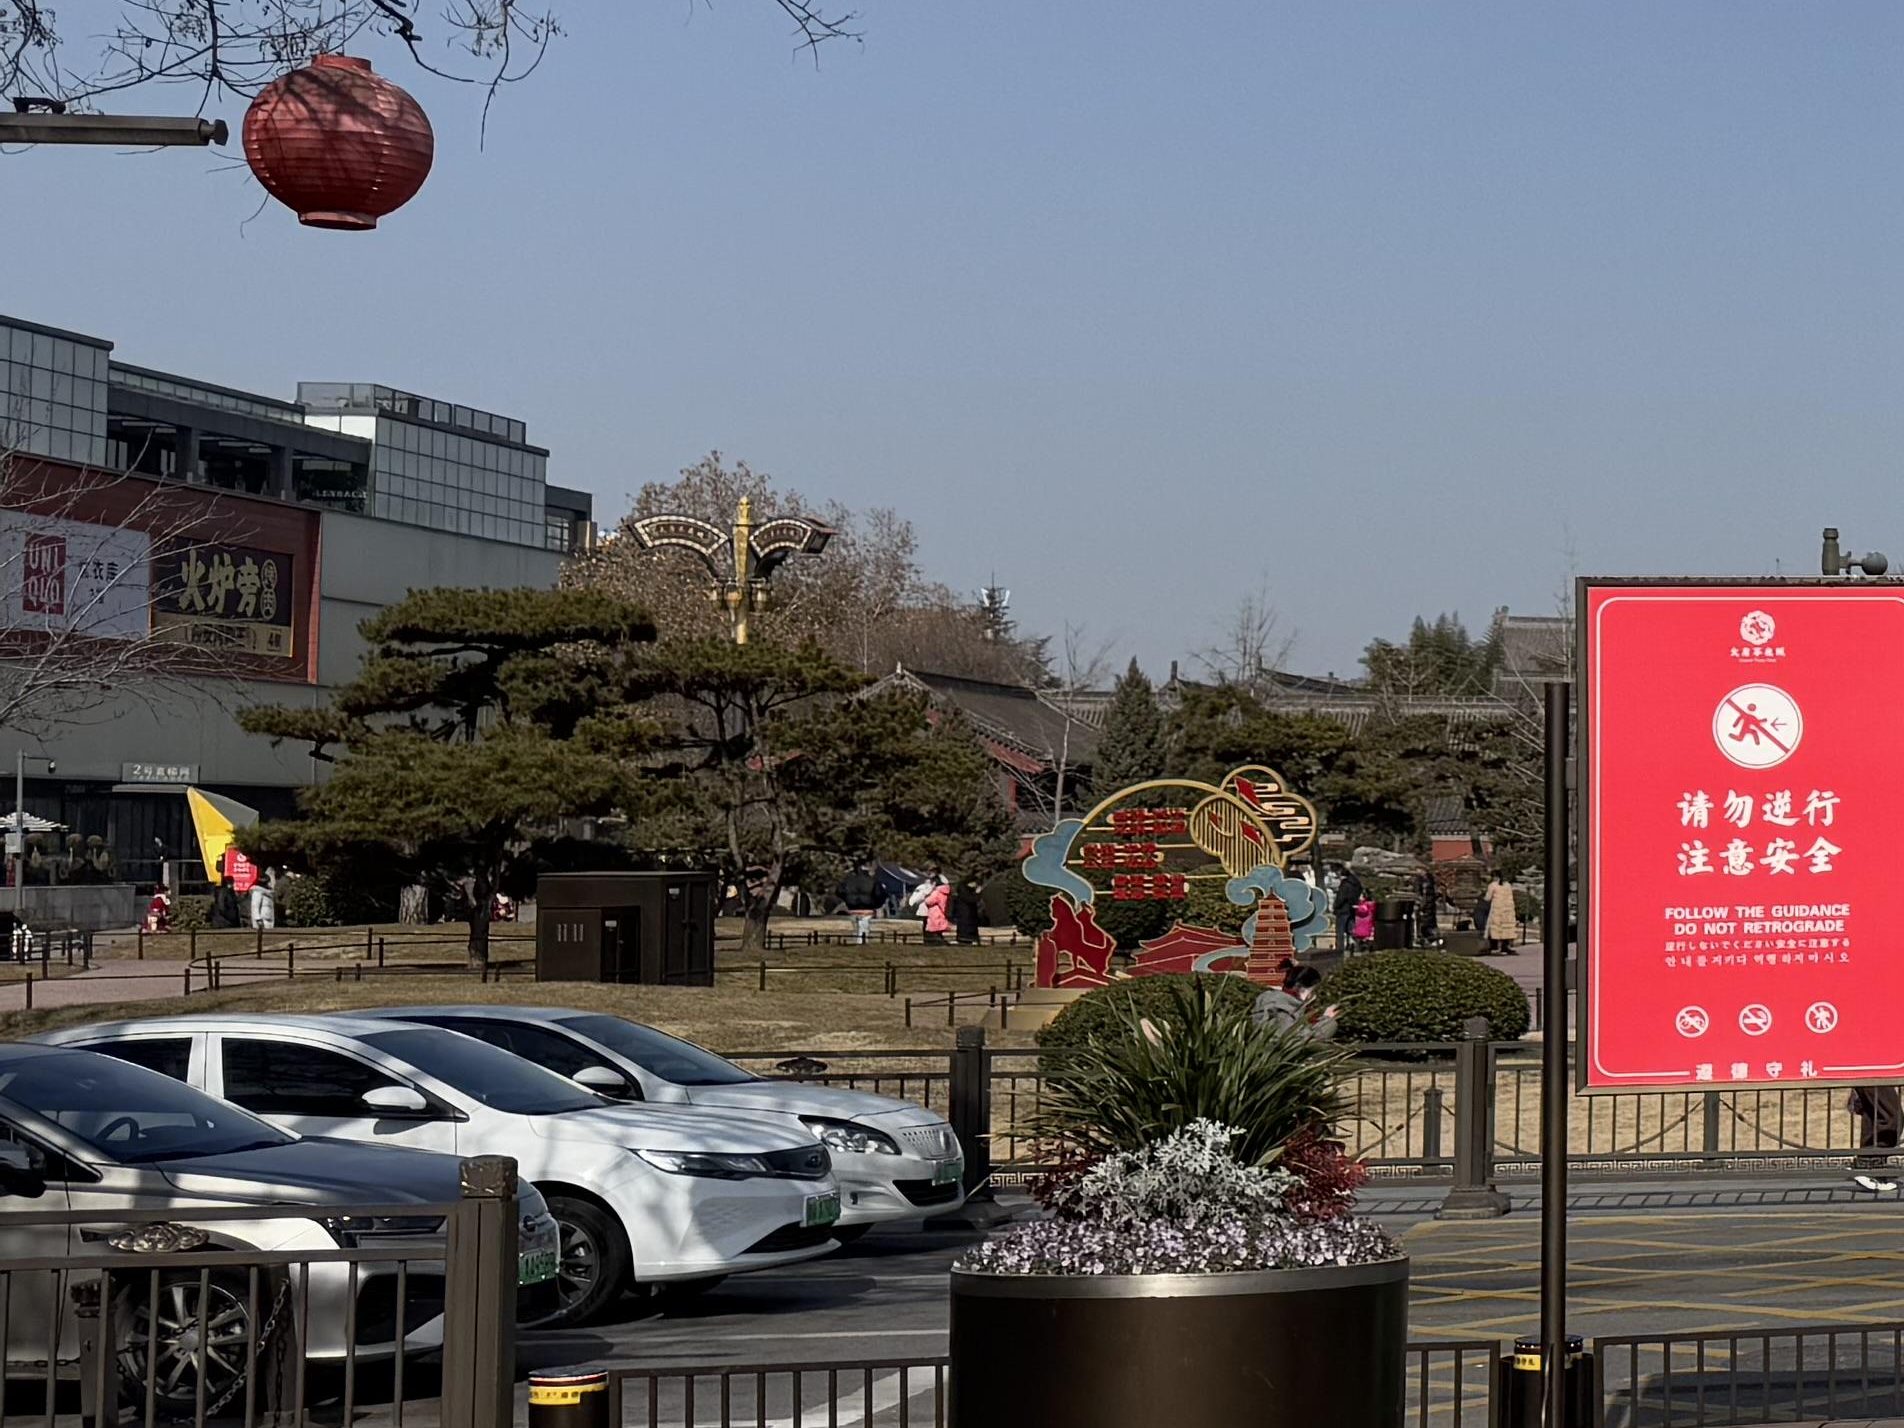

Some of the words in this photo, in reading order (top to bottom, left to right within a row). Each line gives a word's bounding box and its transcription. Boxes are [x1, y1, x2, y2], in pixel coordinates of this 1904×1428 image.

[179, 549, 261, 617] 火炉旁
[1676, 789, 1841, 828] 请勿逆行
[1677, 836, 1842, 876] 注意安全
[1665, 907, 1729, 919] FOLLOW
[1735, 906, 1765, 918] THE
[1771, 904, 1850, 917] GUIDANCE
[1674, 923, 1697, 935] DO
[1704, 922, 1737, 935] NOT
[1743, 920, 1845, 934] RETROGRADE
